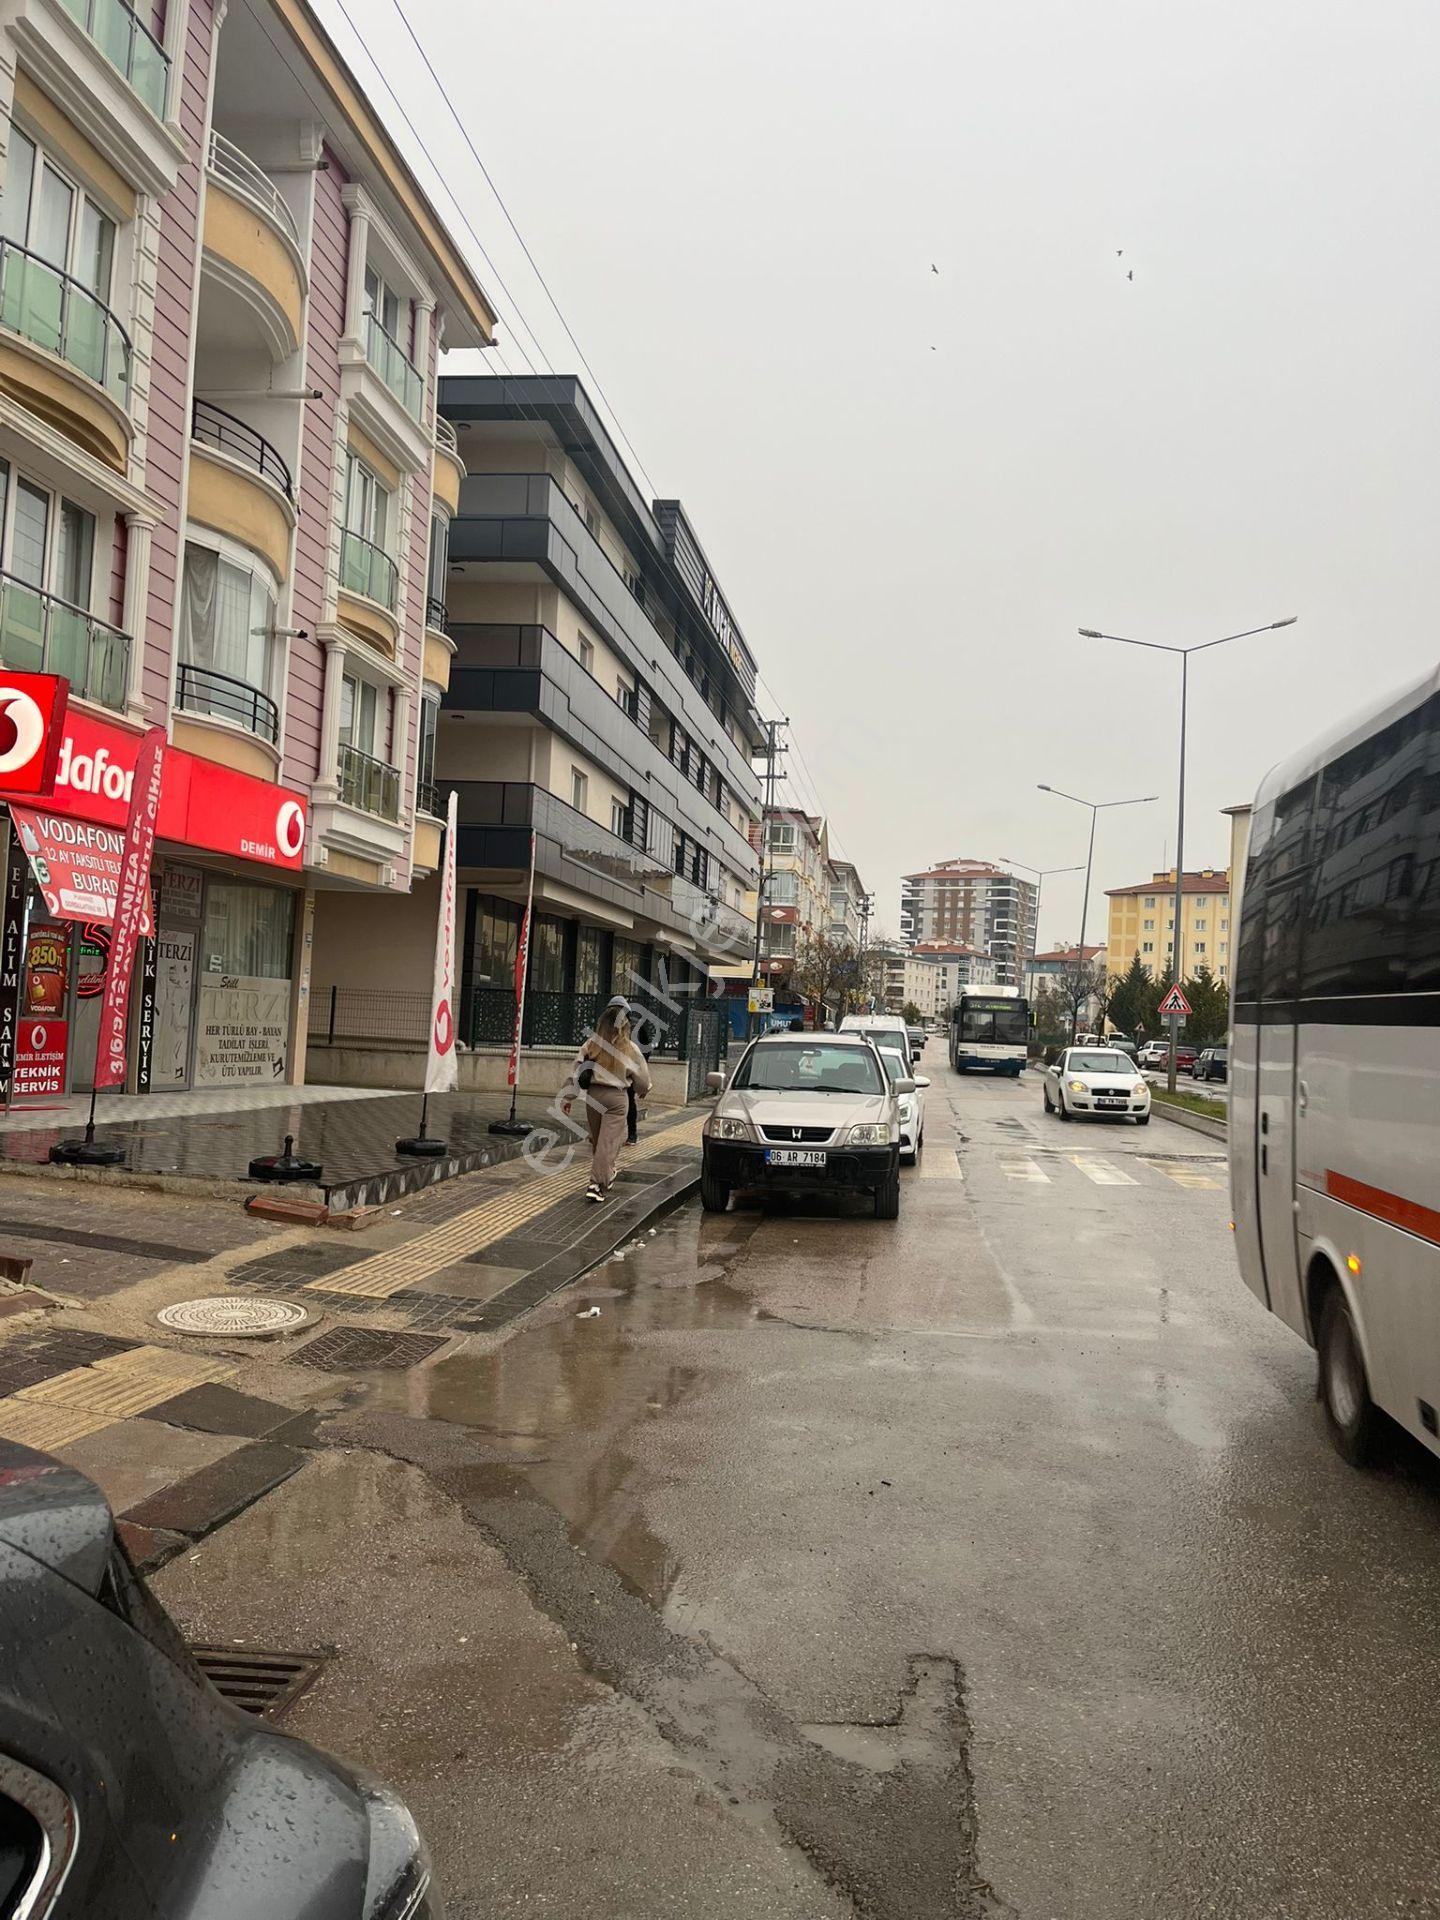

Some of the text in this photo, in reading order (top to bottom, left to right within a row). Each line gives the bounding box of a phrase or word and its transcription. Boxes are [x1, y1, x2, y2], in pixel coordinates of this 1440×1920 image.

[132, 811, 143, 845] EK
[45, 846, 58, 862] 12
[59, 849, 70, 864] AY
[11, 867, 20, 899] EL
[3, 920, 18, 987] ALIM
[31, 945, 57, 965] 850
[123, 940, 133, 973] AY
[159, 942, 193, 961] TERZİ
[139, 995, 153, 1084] SERVİS
[206, 1025, 219, 1036] HER
[246, 1026, 258, 1036] BAY
[0, 1008, 12, 1092] SATM
[16, 1052, 33, 1061] EMİR
[14, 1065, 60, 1078] TEKNİK
[222, 1065, 236, 1077] ÜTÜ
[13, 1079, 59, 1093] SERVİS
[771, 1151, 781, 1161] 06
[787, 1152, 798, 1162] AR
[803, 1152, 825, 1163] 7184
